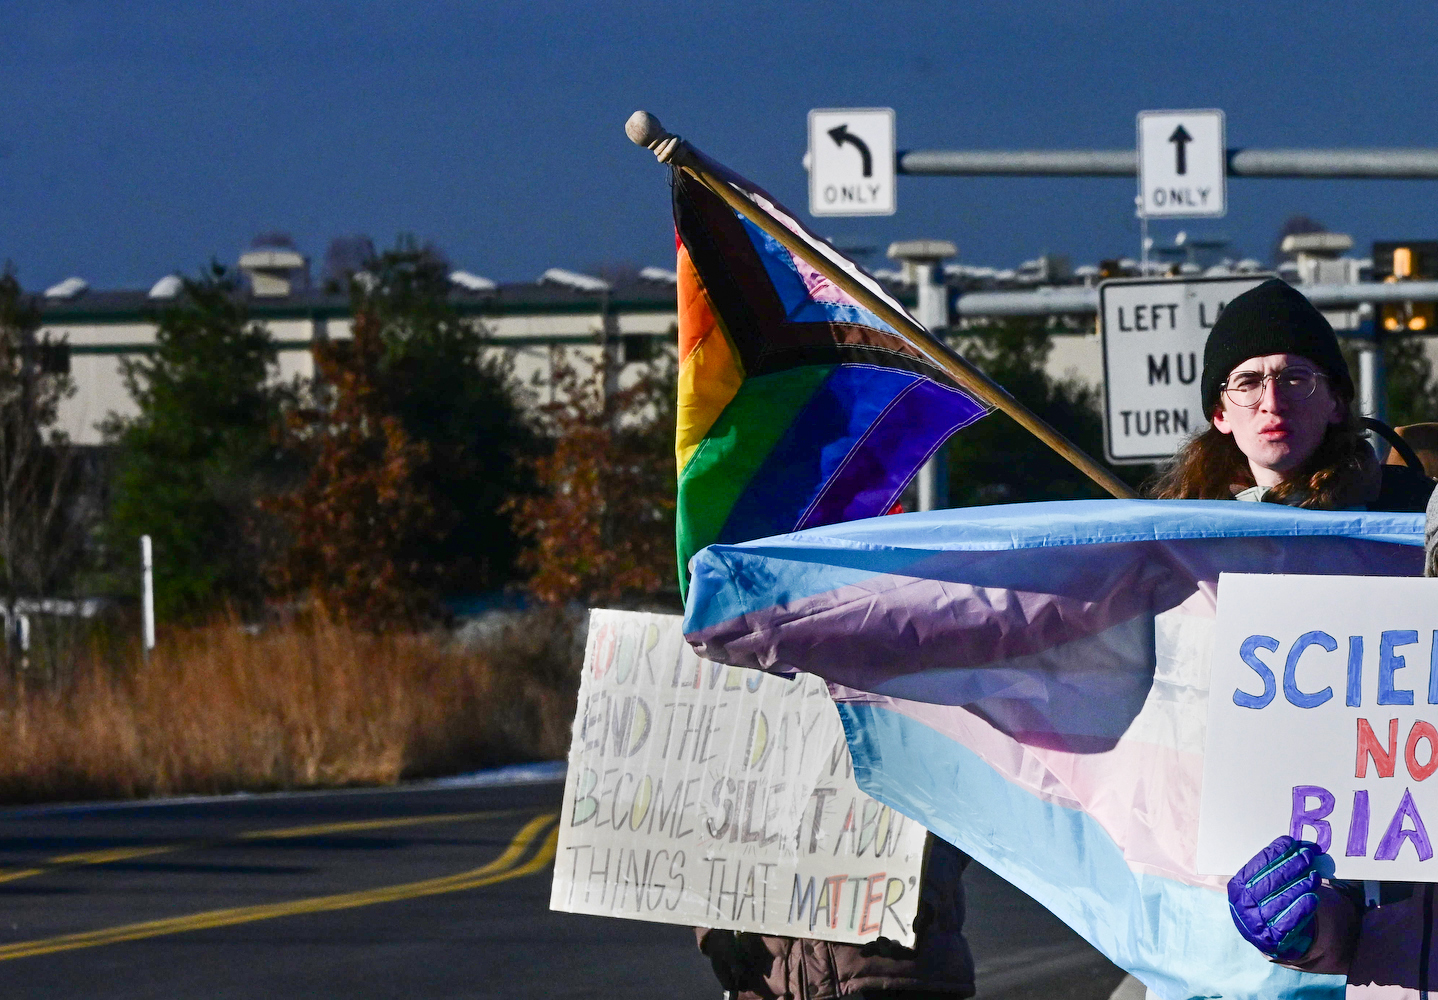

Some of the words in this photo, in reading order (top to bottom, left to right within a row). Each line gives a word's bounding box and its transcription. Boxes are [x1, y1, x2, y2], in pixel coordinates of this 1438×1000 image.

[824, 184, 880, 205] ONLY
[1153, 186, 1211, 208] ONLY
[1118, 303, 1179, 332] LEFT
[1147, 352, 1197, 386] MU
[1120, 409, 1190, 437] TURN
[580, 690, 652, 758] END
[662, 702, 728, 764] THE
[742, 707, 821, 776] DAY
[570, 767, 700, 839] BECOME
[833, 797, 911, 863] ABOU
[566, 844, 686, 912] THINGS
[702, 858, 778, 924] THAT
